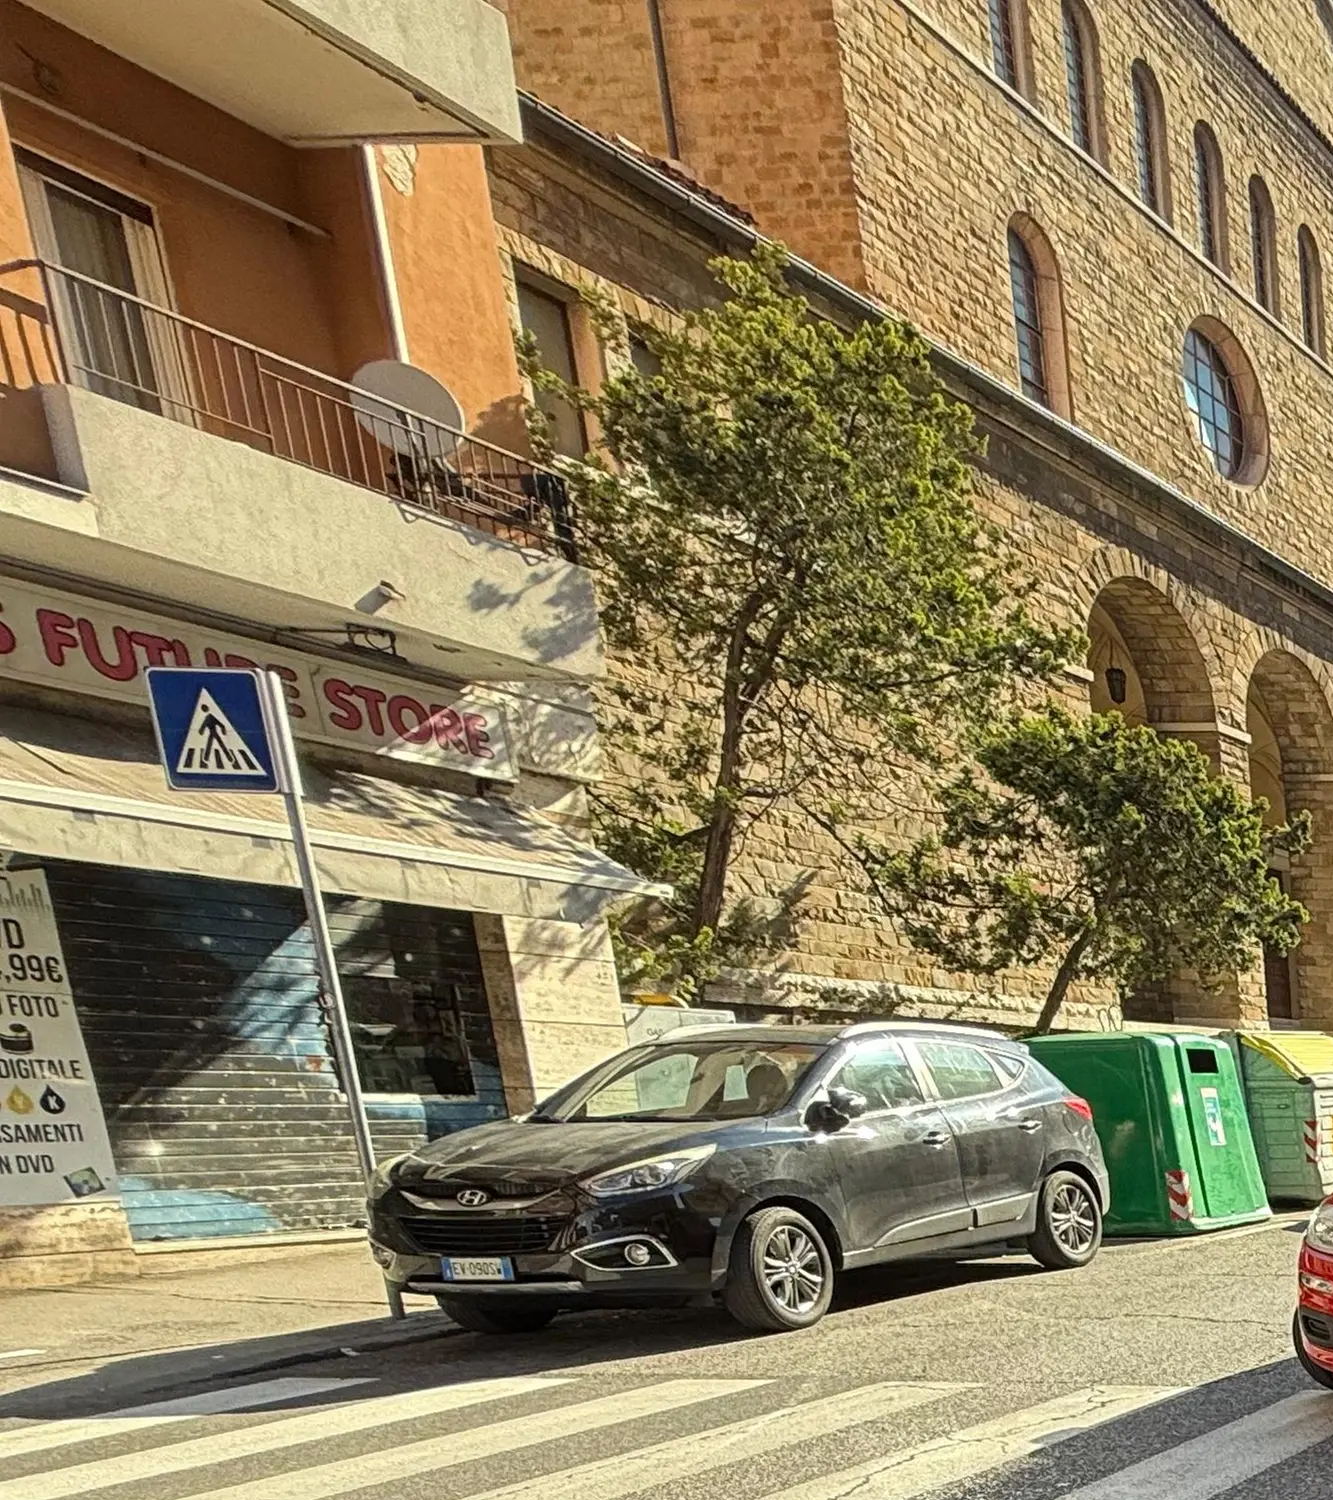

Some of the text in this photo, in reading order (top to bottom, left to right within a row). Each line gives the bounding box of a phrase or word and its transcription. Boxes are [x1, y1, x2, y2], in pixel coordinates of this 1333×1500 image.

[323, 678, 495, 759] STORE
[0, 953, 63, 984] ,99€
[6, 994, 60, 1018] FOTO
[0, 1058, 85, 1080] DIGITALE
[0, 1123, 85, 1143] SAMENTI
[16, 1154, 55, 1174] DVD
